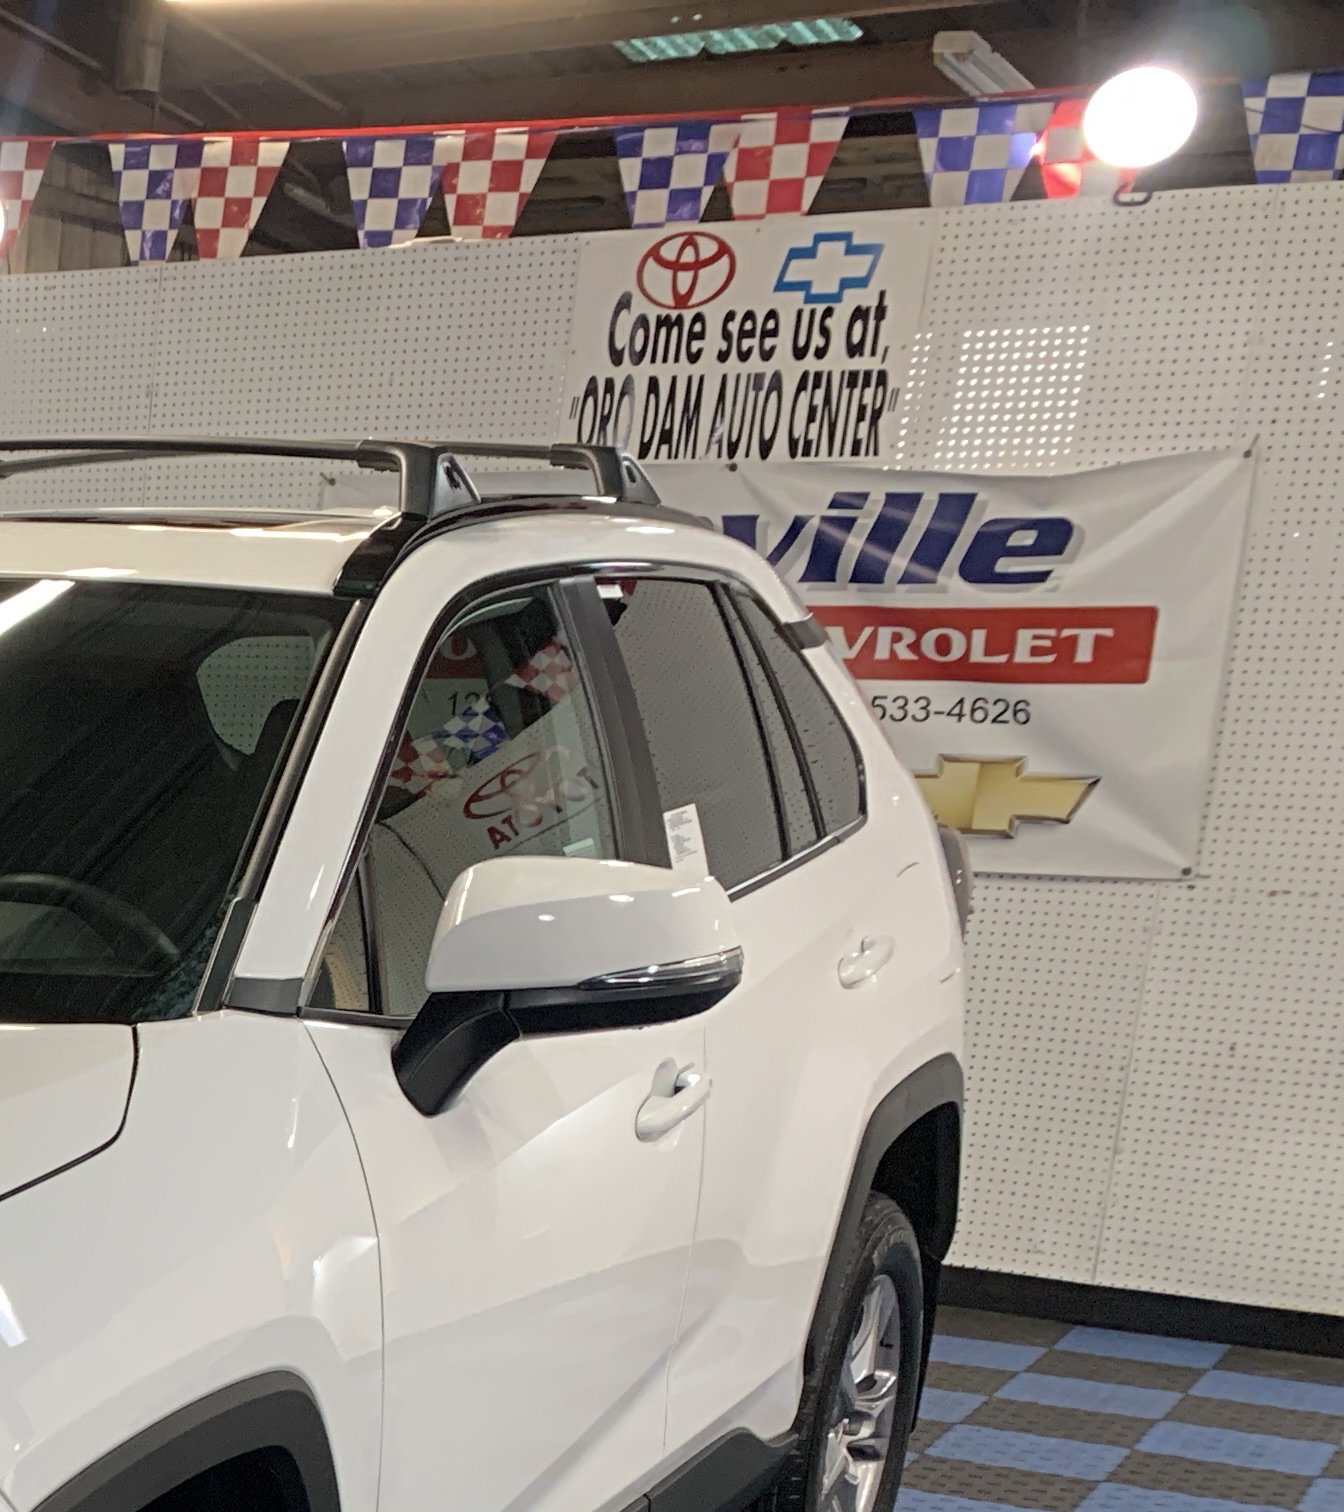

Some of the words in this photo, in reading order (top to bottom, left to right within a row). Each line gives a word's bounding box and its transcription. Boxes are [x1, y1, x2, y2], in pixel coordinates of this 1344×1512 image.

[608, 291, 706, 367] Come
[716, 308, 780, 364] see
[792, 306, 835, 361] us
[846, 289, 889, 364] at,
[638, 374, 705, 460] DAM
[705, 369, 783, 461] AUTO
[788, 369, 900, 460] CENTER"
[722, 491, 1076, 585] ville
[824, 626, 1115, 664] VROLET
[871, 695, 1032, 725] 533-4626
